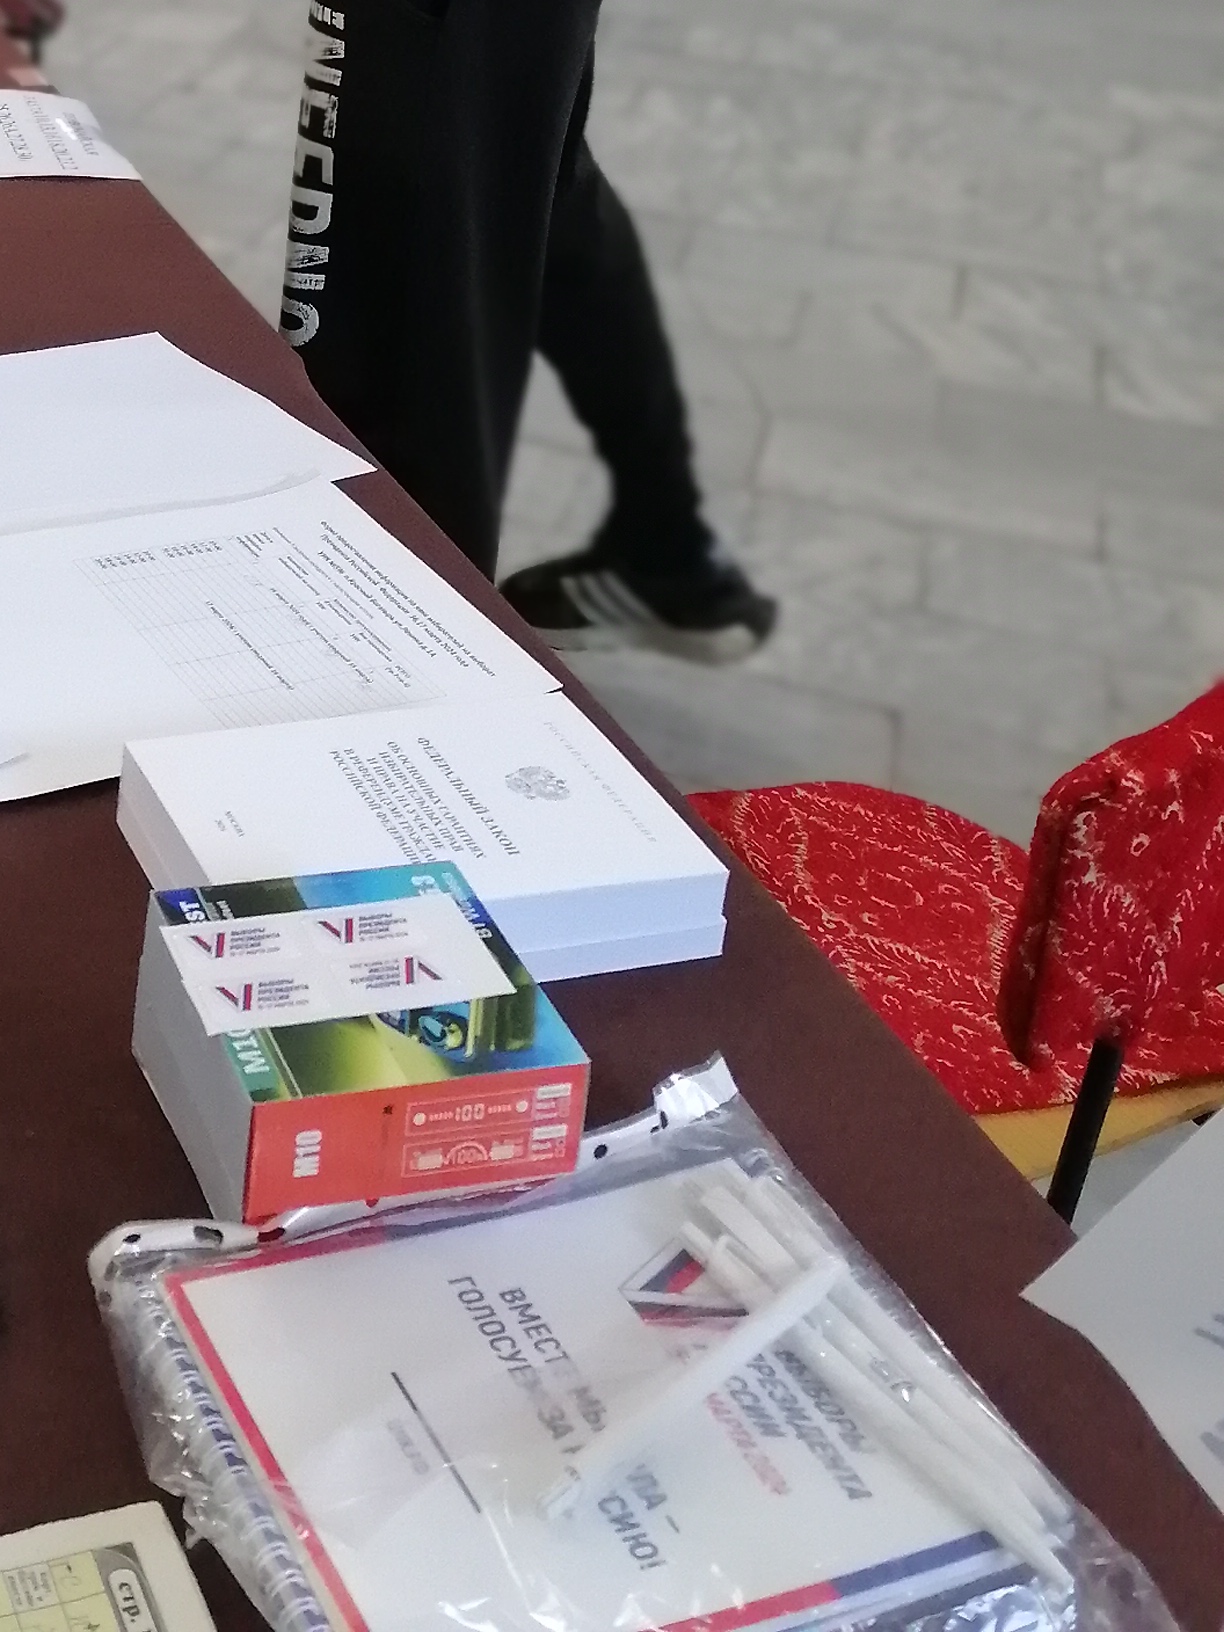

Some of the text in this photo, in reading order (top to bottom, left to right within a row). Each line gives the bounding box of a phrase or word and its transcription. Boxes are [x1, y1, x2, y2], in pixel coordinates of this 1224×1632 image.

[326, 750, 382, 810] РОССИЙСКОЙ
[376, 751, 445, 826] ИЗБИРАТЕЛЬНЫХ
[436, 828, 465, 852] ПРАВ
[394, 754, 444, 804] ОСНОВНЫХ
[435, 805, 487, 859] ГАРАНТИЯХ
[413, 737, 490, 814] ФЕДЕРАЛЬНЫЙ
[477, 815, 524, 855] ЗАКОН
[404, 808, 446, 850] УЧАСТИЕ
[292, 1128, 322, 1179] M10
[532, 1407, 577, 1438] ЗА
